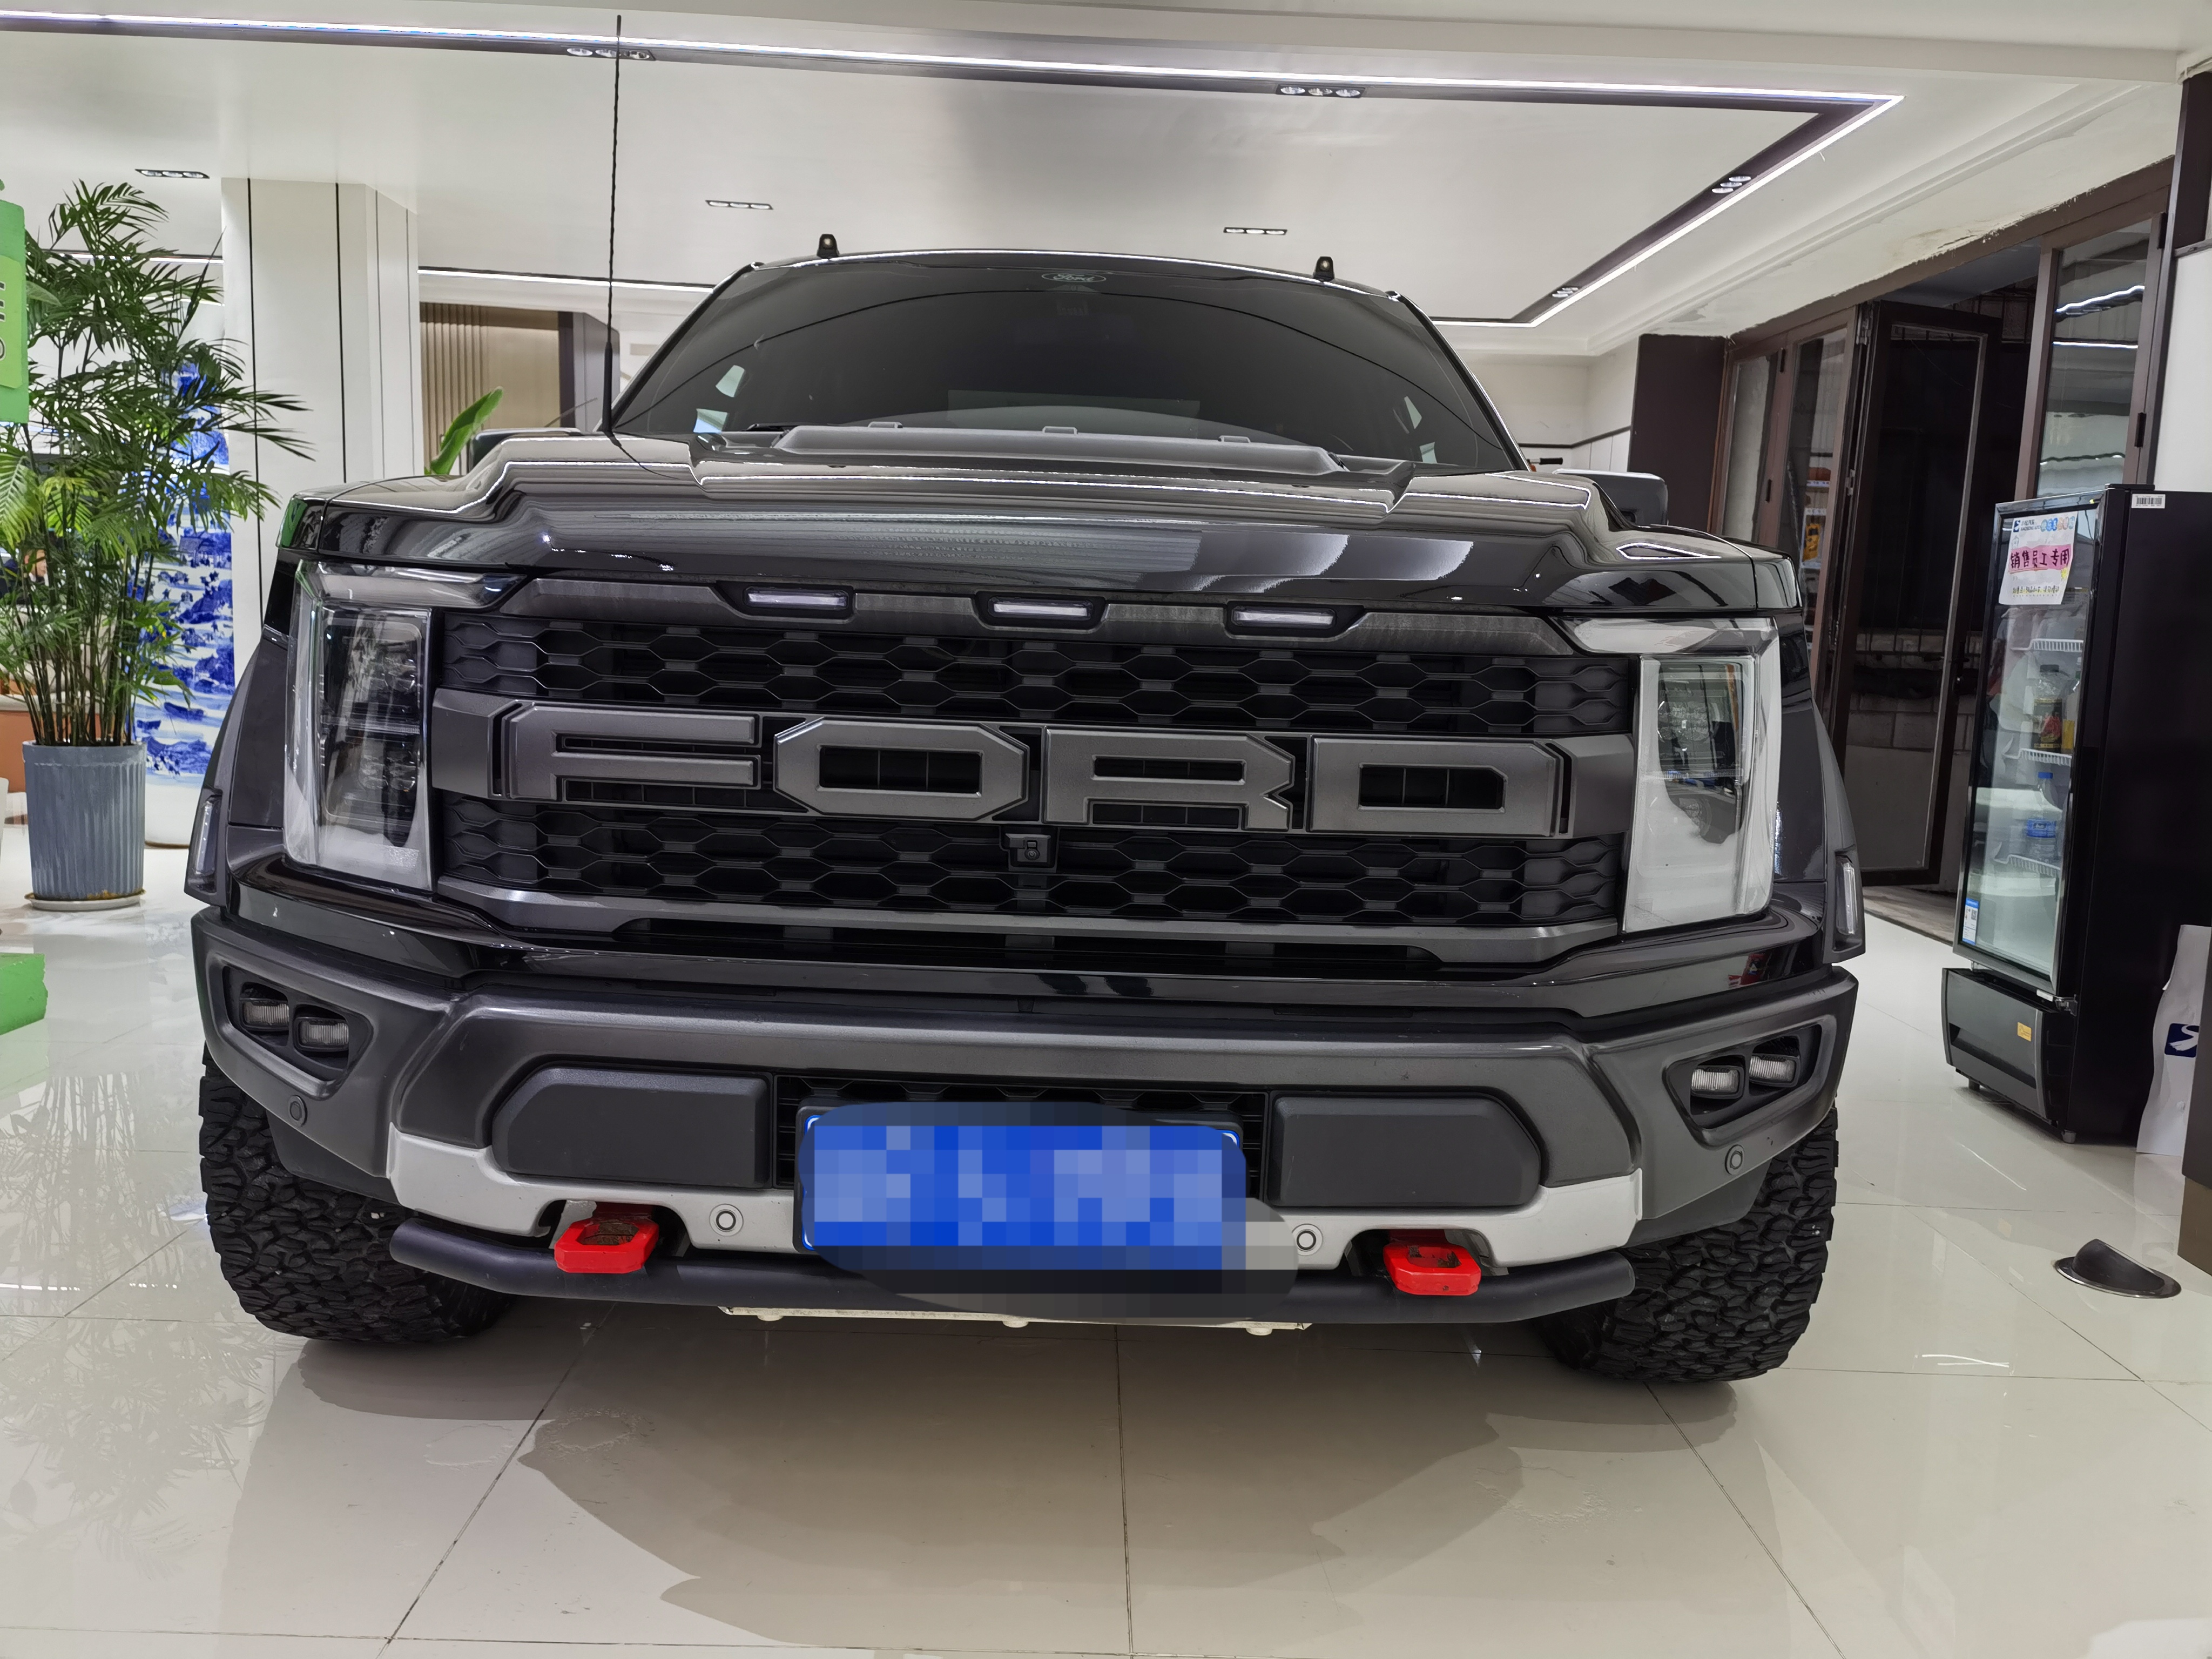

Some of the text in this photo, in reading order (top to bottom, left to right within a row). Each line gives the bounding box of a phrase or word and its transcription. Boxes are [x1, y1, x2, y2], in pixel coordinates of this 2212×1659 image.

[1053, 273, 1095, 282] Ford
[2010, 548, 2070, 569] 销售员工专用
[504, 702, 1559, 838] FORD
